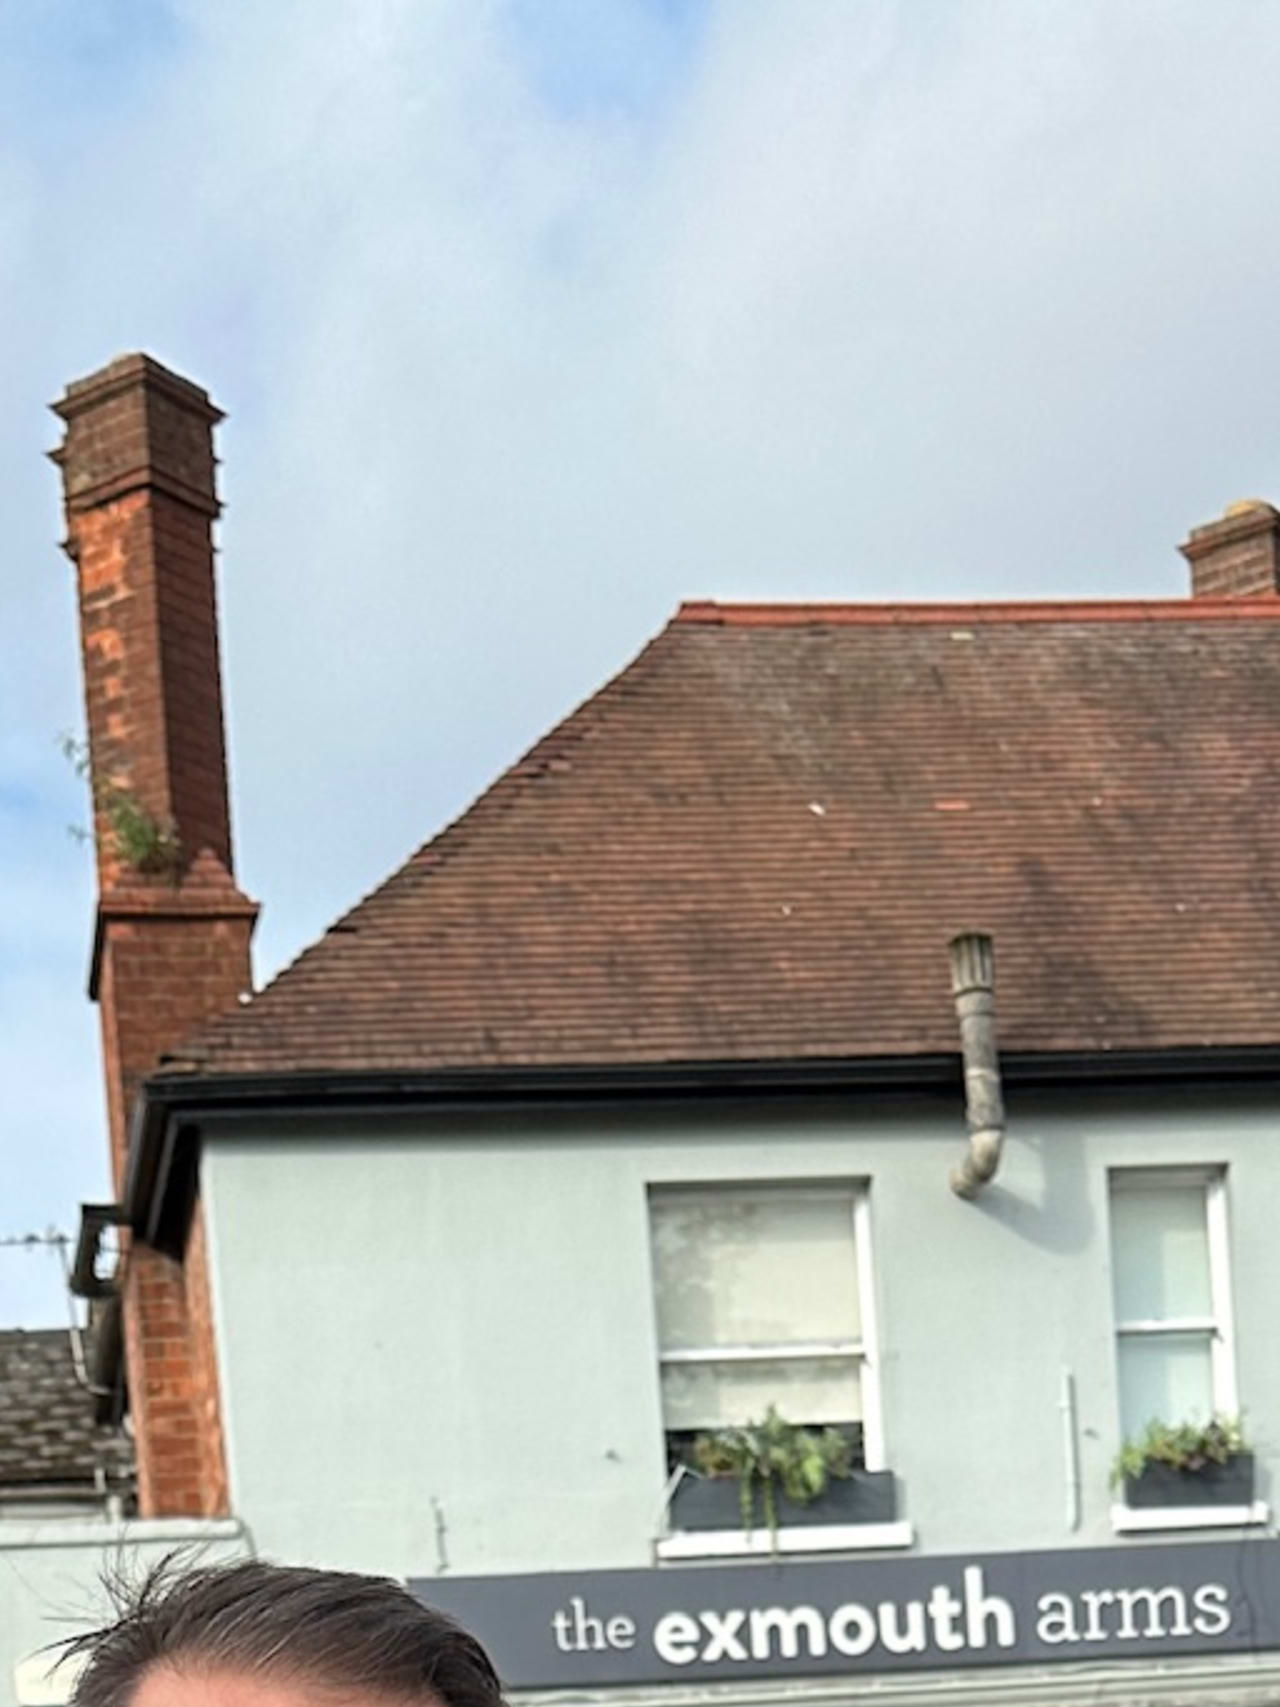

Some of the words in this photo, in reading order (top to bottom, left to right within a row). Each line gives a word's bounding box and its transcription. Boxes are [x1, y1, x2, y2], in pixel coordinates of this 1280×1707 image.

[552, 1597, 635, 1651] the
[654, 1565, 1016, 1664] exmouth
[1036, 1583, 1231, 1643] arms
